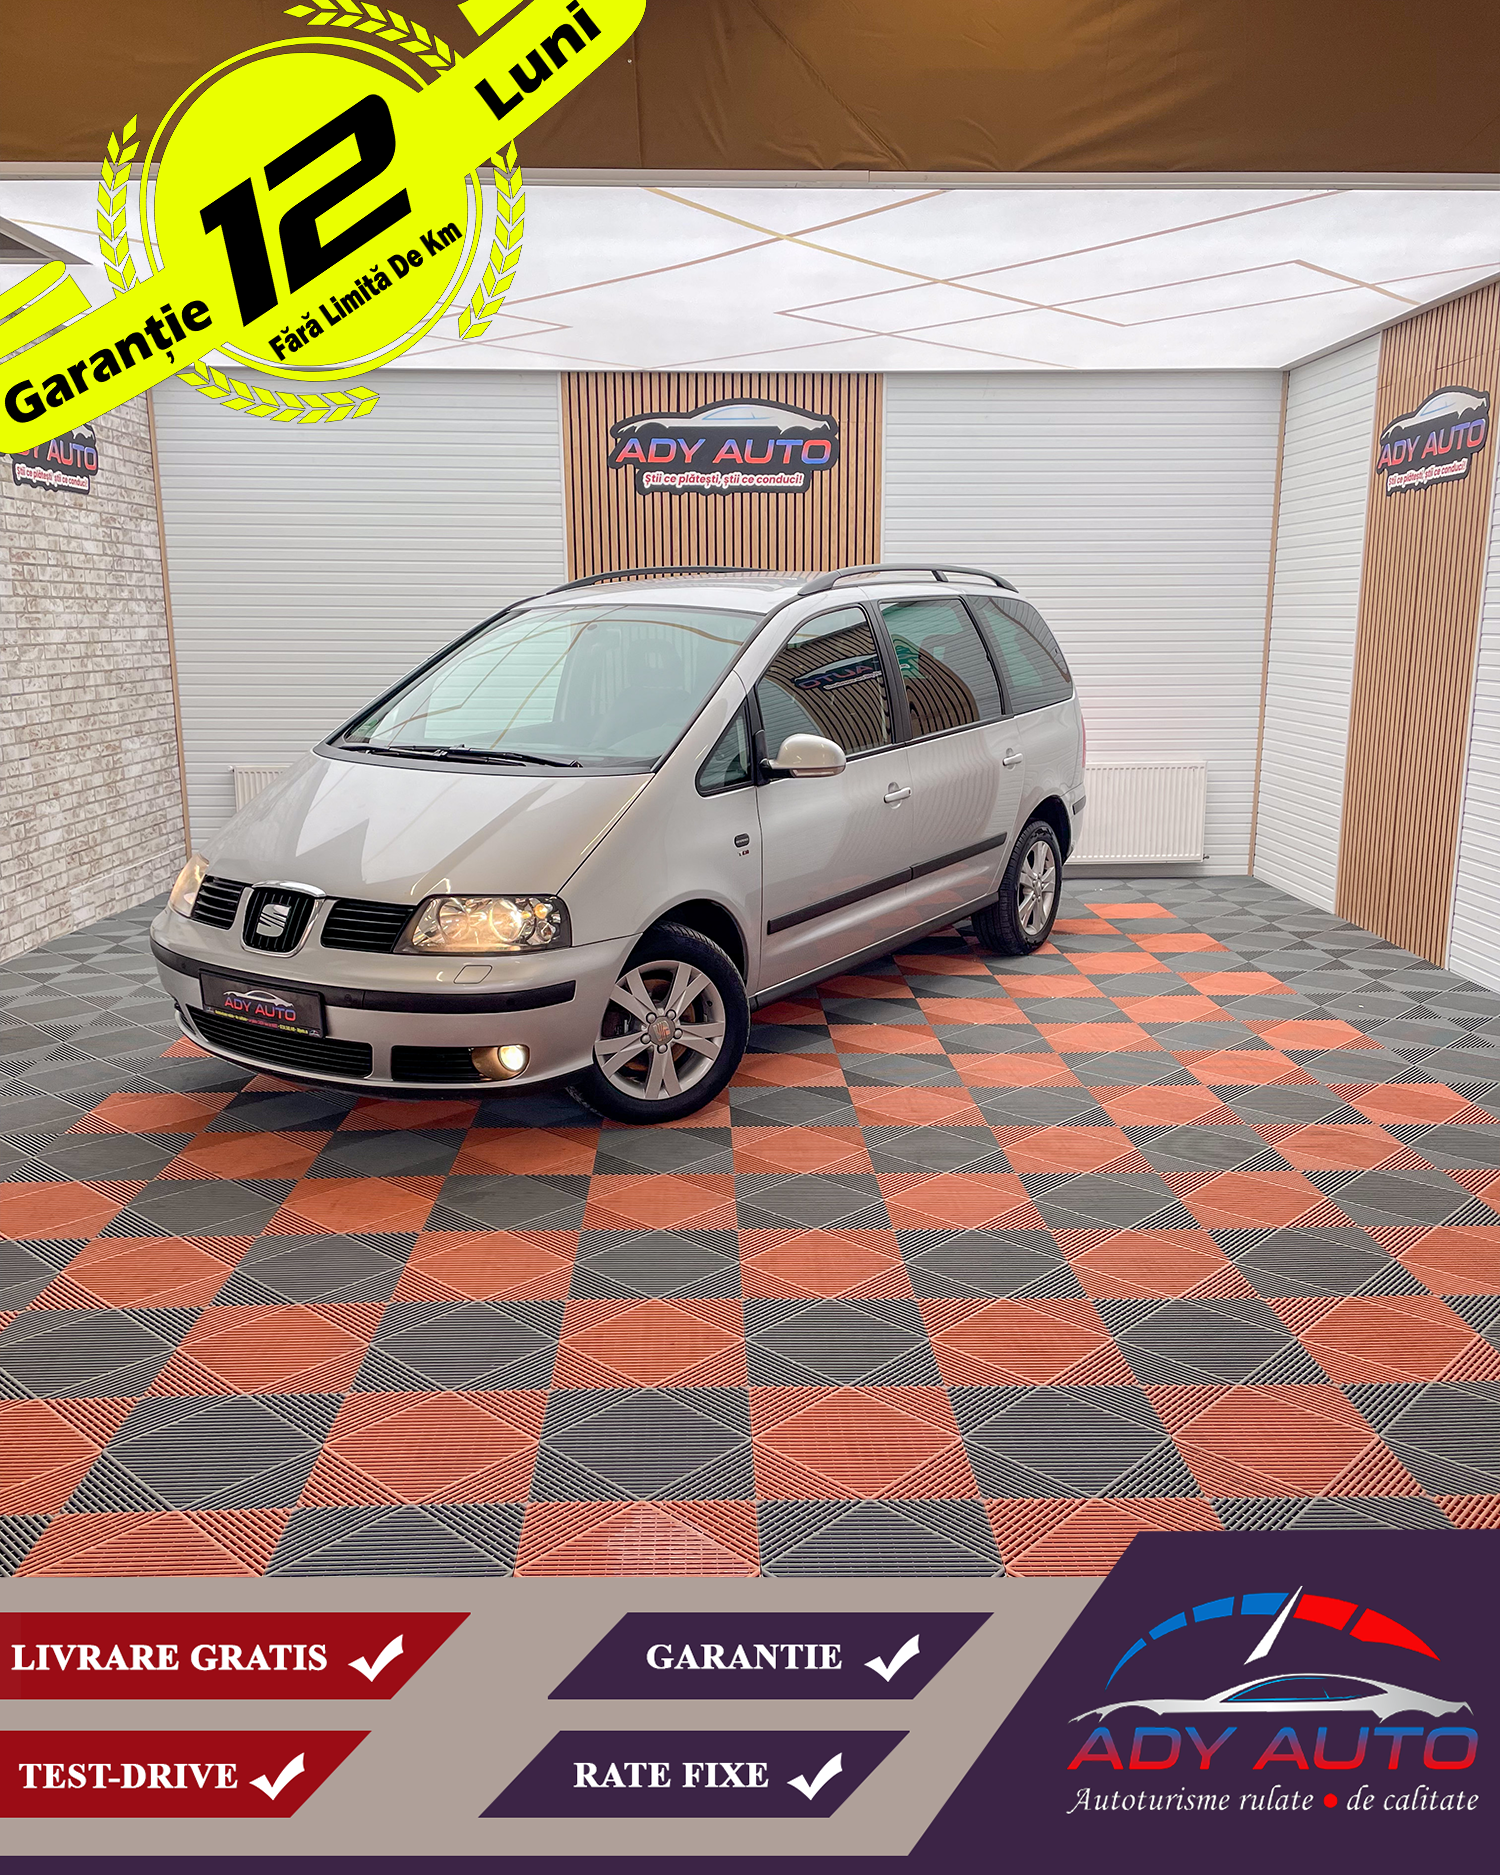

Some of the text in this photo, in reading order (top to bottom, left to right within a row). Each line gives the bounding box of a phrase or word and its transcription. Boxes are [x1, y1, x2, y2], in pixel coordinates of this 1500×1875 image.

[46, 438, 97, 471] AUTO
[615, 437, 832, 464] ADY AUTO
[1378, 418, 1486, 469] ADY AUTO
[663, 475, 676, 483] ce
[743, 476, 755, 484] ce
[756, 473, 803, 485] conduci!
[224, 996, 252, 1013] ADY
[254, 1003, 297, 1022] AUTO
